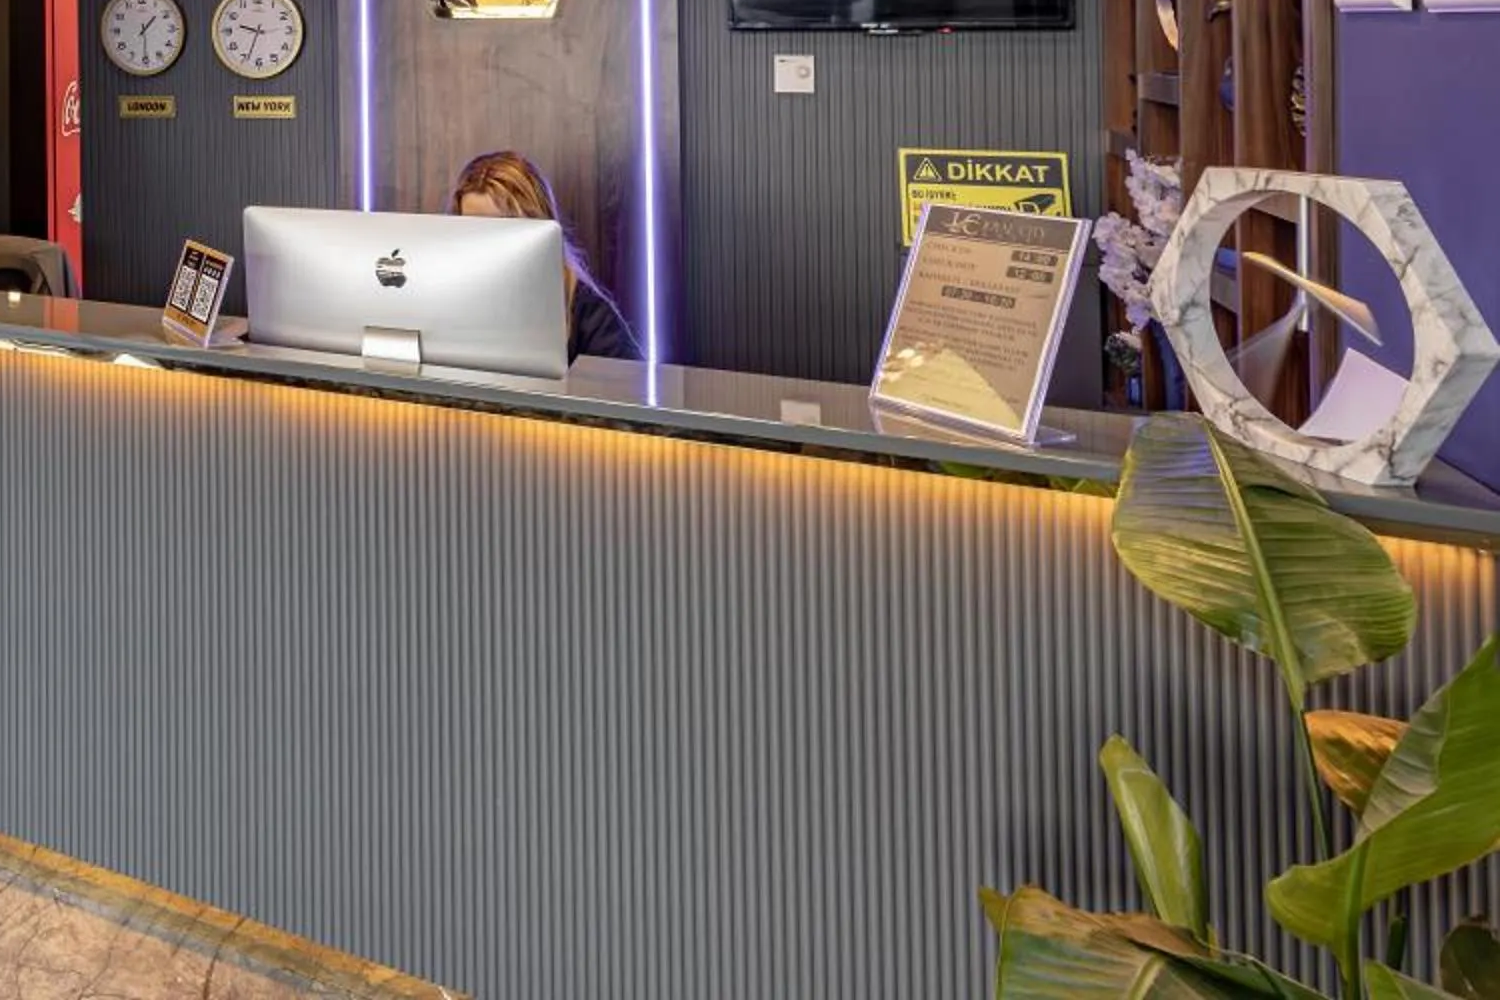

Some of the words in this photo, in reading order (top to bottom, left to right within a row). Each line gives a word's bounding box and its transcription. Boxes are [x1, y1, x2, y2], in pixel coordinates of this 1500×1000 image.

[237, 101, 260, 111] NEW
[263, 101, 291, 112] YORK
[946, 159, 1049, 183] DİKKAT
